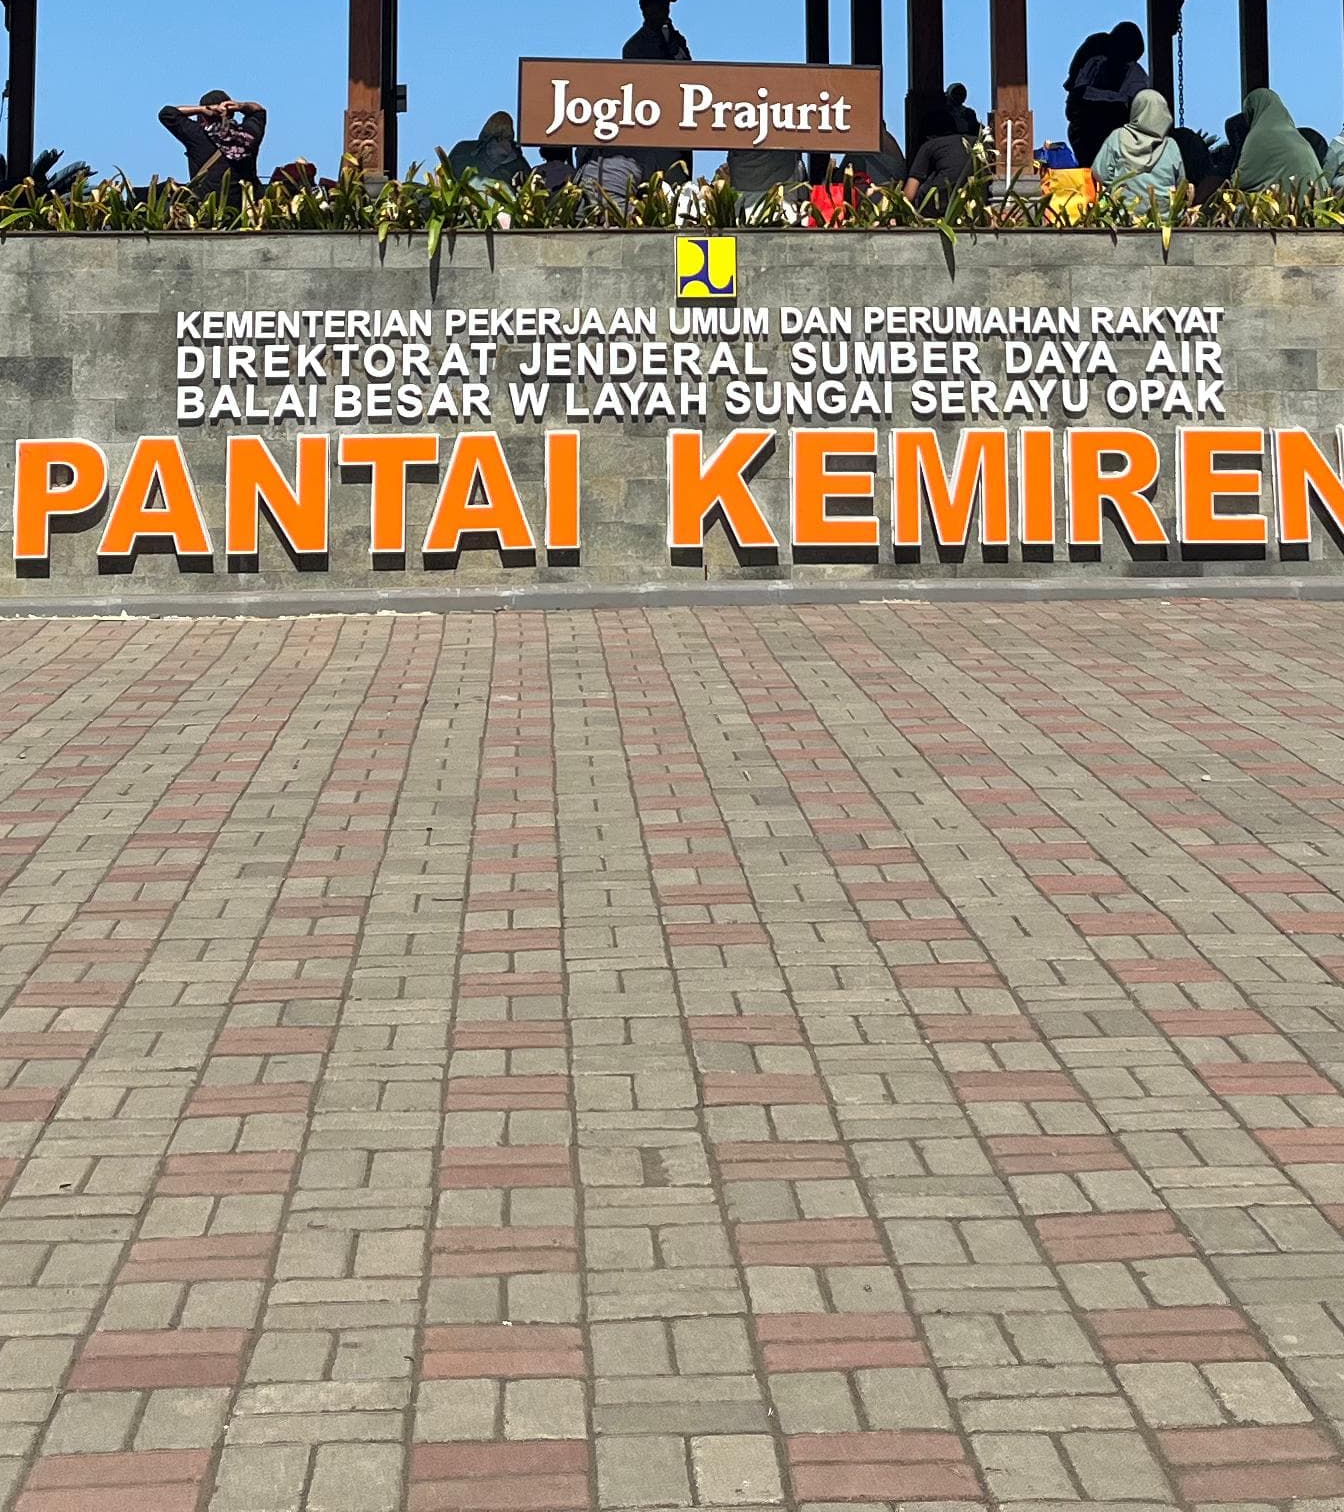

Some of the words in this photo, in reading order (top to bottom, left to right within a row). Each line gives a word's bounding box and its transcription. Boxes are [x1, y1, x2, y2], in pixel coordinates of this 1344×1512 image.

[546, 79, 661, 140] Joglo
[678, 83, 852, 145] Prajurit
[176, 309, 432, 339] KEMENTERIAN
[445, 306, 656, 337] PEKERJAAN
[669, 306, 769, 336] UMUM
[780, 307, 852, 335] DAN
[864, 306, 1080, 335] PERUMAHAN
[1091, 306, 1225, 334] RAKYAT
[176, 342, 497, 379] DIREKTORAT
[519, 341, 768, 377] JENDERAL
[790, 340, 981, 375] SUMBER
[1004, 340, 1118, 375] DAYA
[1145, 340, 1224, 375] AIR
[176, 383, 318, 419] BALAI
[334, 382, 491, 418] BESAR
[724, 380, 893, 416] SUNGAI
[910, 379, 1089, 415] SERAYU
[1105, 379, 1226, 414] OPAK
[14, 430, 581, 559] PANTAI
